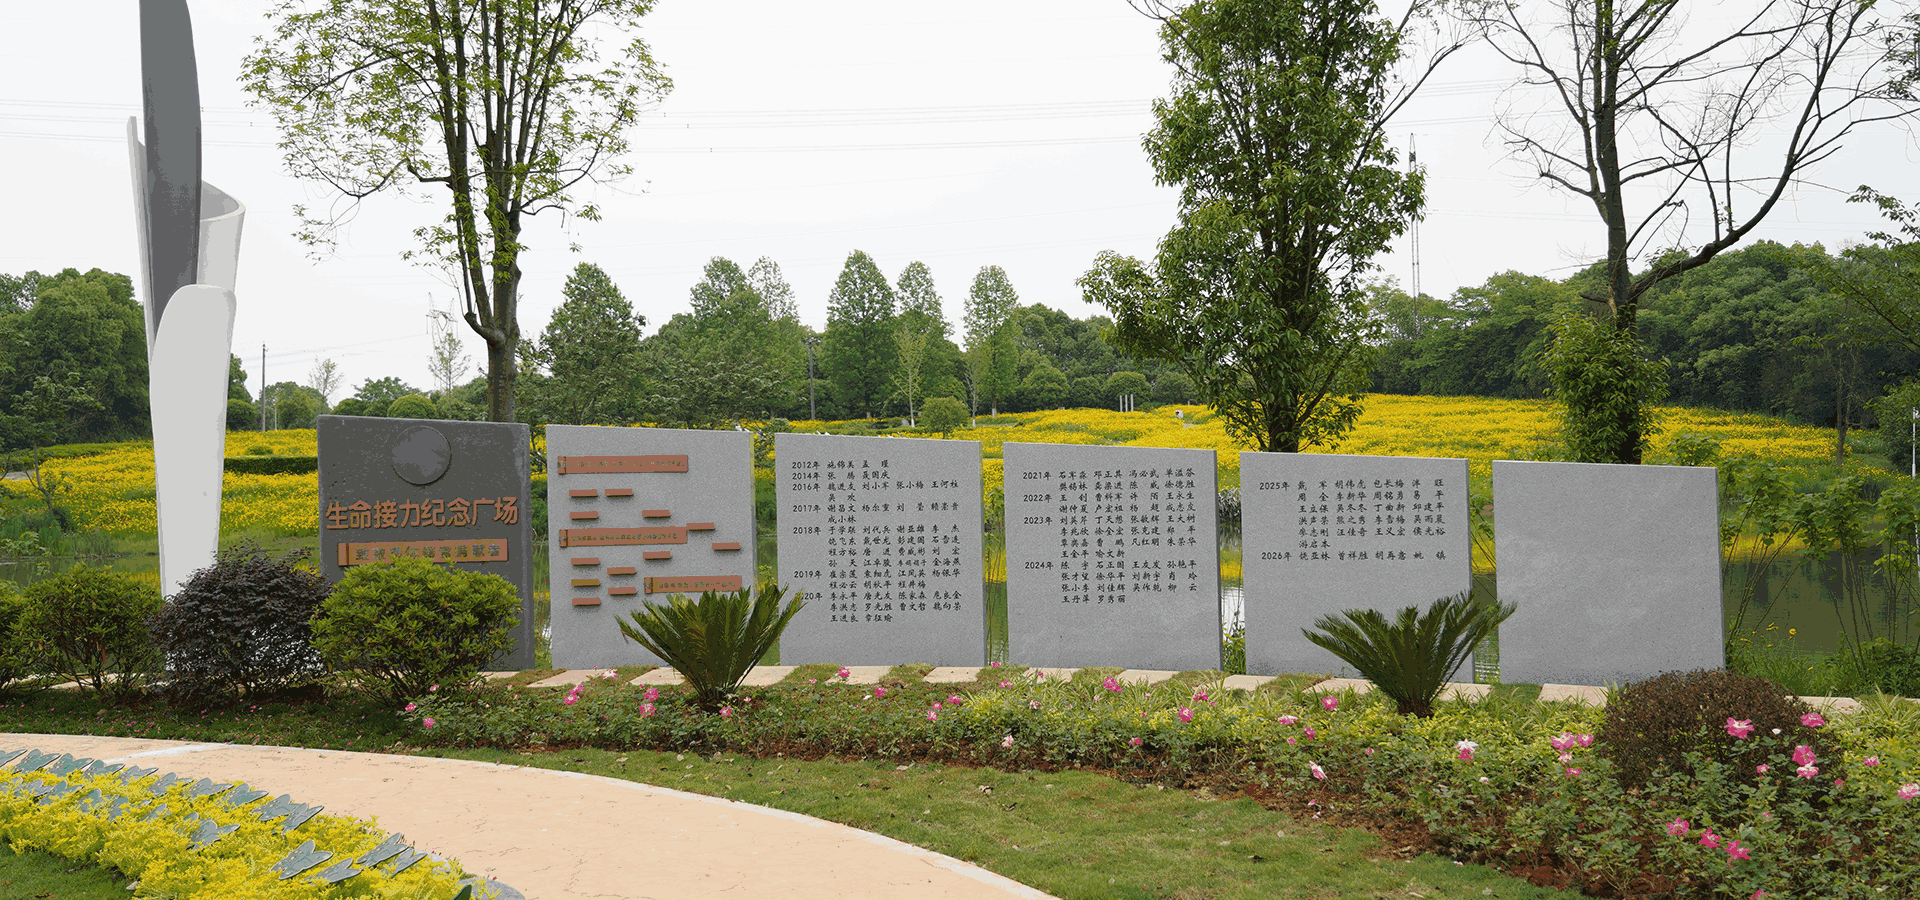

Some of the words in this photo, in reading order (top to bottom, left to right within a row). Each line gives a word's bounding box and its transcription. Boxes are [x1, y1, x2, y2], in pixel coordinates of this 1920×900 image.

[791, 460, 821, 470] 2012年
[792, 471, 821, 481] 2014年
[1022, 471, 1052, 481] 2021年
[792, 482, 821, 492] 2016年
[1259, 481, 1290, 491] 2025年
[1023, 493, 1053, 503] 2022年
[326, 497, 519, 530] 生命接力纪念广场
[792, 504, 821, 513] 2017年
[1023, 516, 1053, 526] 2023年
[792, 526, 821, 536] 2018年
[1261, 551, 1292, 561] 2026年
[1024, 561, 1054, 571] 2024年
[793, 569, 822, 580] 2019年
